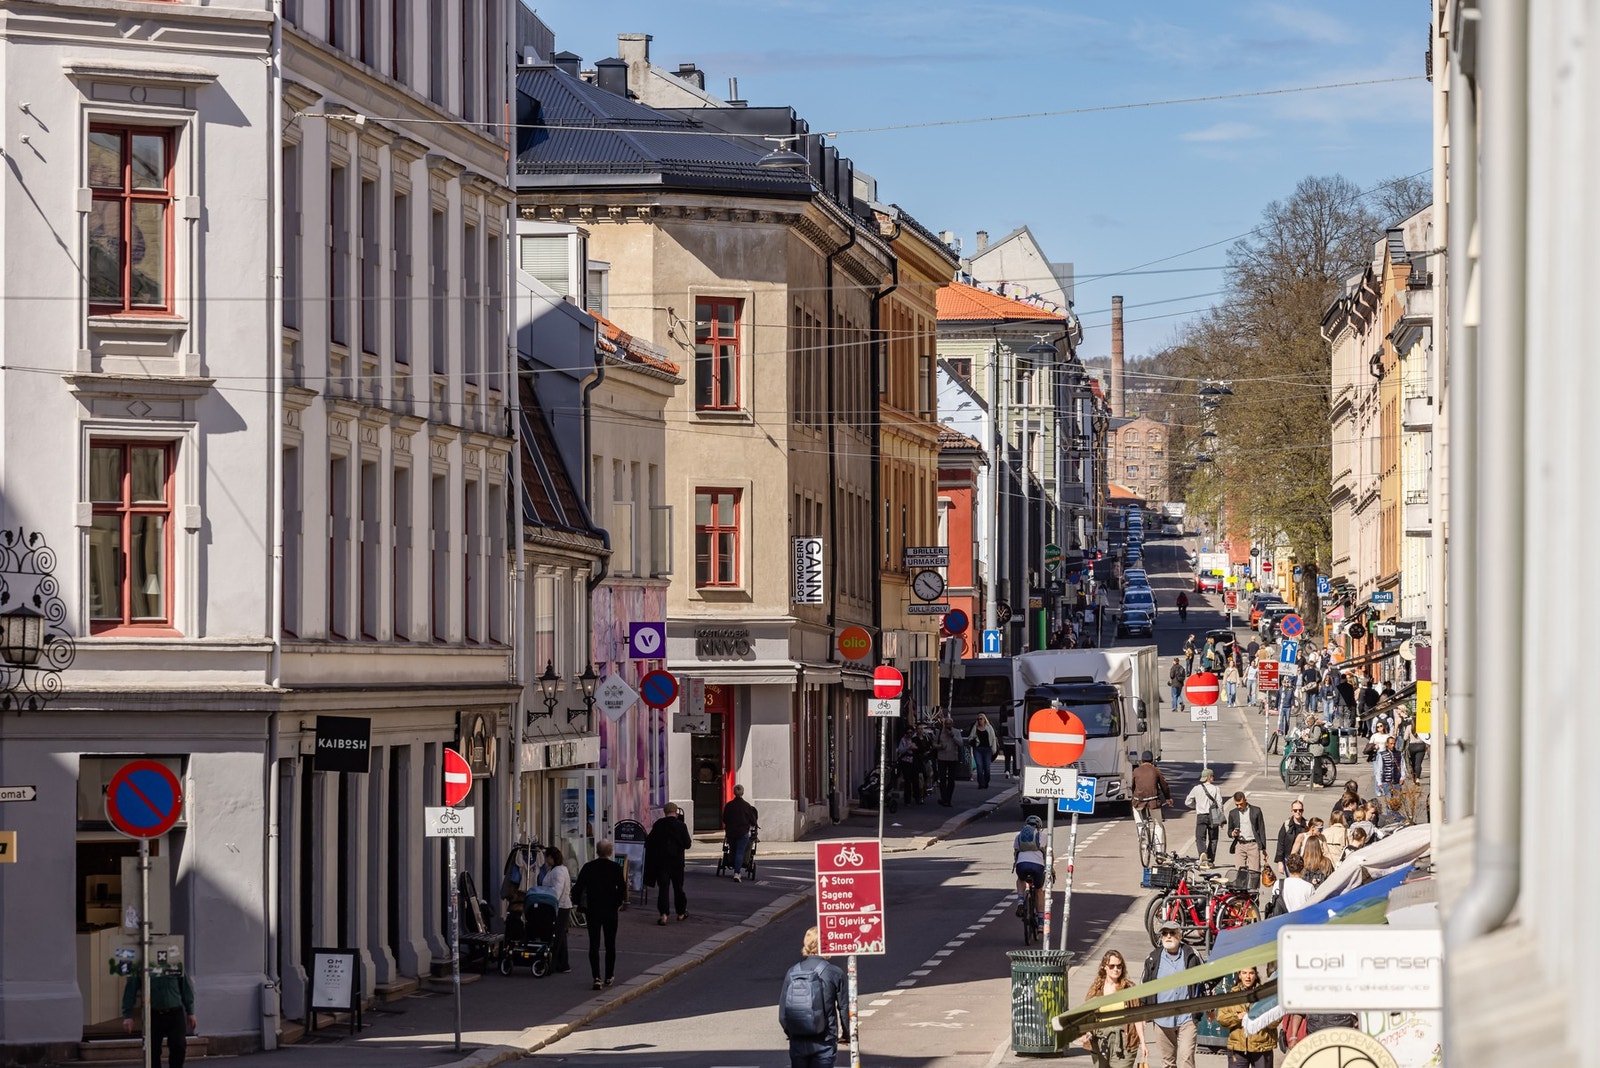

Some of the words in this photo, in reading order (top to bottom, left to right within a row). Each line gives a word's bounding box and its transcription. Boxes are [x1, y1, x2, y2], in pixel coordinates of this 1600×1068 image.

[805, 540, 822, 602] GANNI
[842, 636, 867, 648] olio
[0, 789, 27, 799] omat
[1035, 787, 1065, 795] unntatt
[437, 826, 464, 834] unntatt
[831, 876, 854, 885] Storo
[822, 891, 853, 900] Sagene
[822, 901, 855, 910] Torshov
[839, 916, 866, 927] Gjøvik
[827, 931, 853, 940] Økern
[829, 943, 858, 951] Sinsen
[1295, 953, 1344, 971] Lojal
